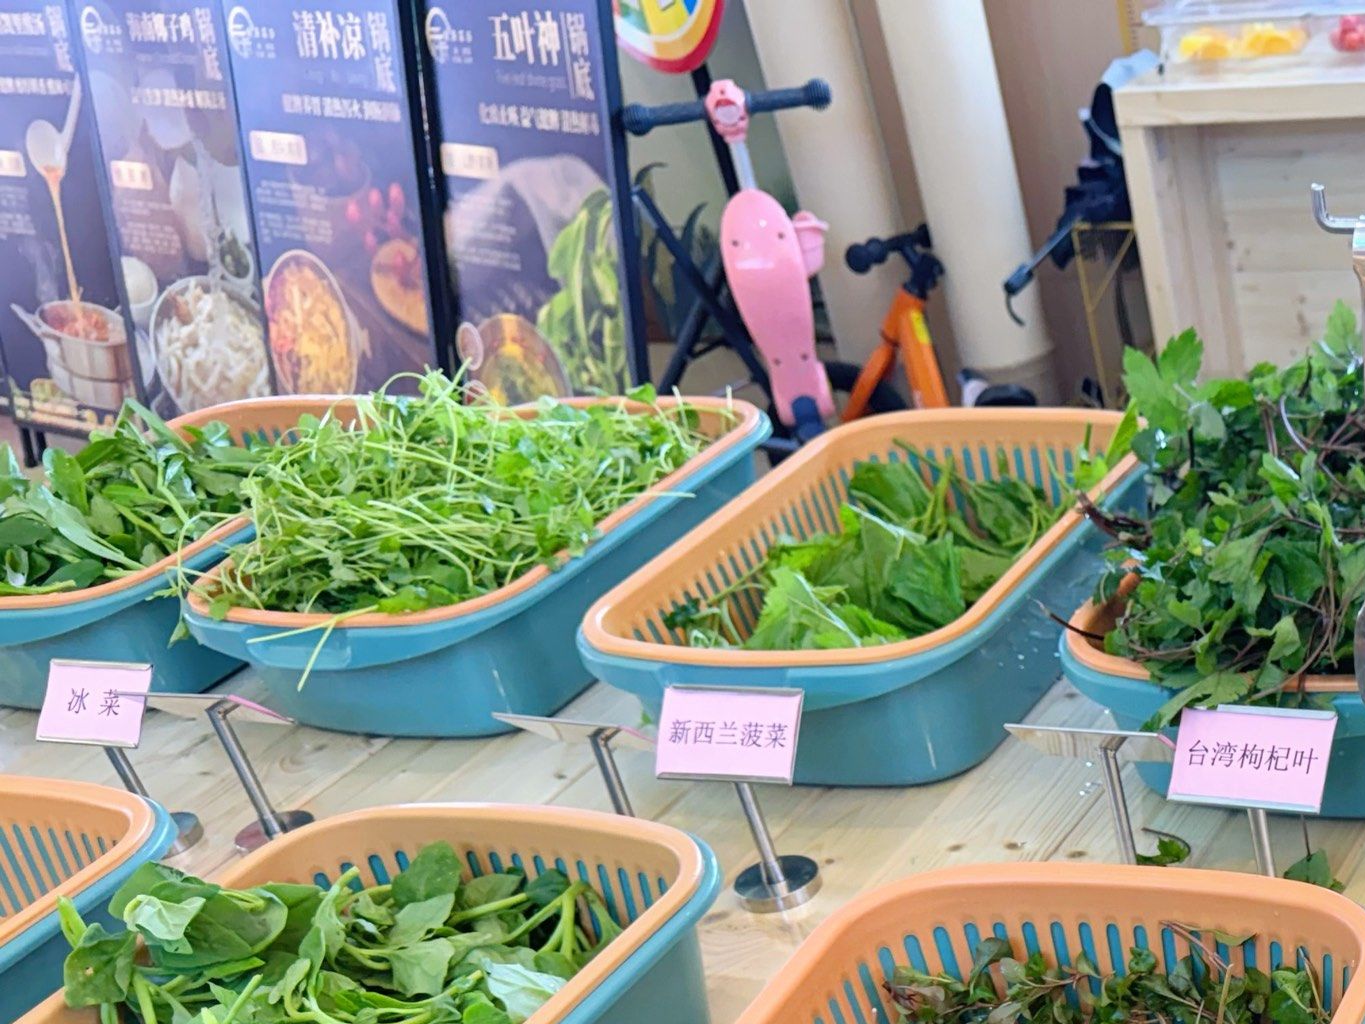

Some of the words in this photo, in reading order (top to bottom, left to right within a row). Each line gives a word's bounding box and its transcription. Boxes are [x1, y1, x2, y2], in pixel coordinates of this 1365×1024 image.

[292, 10, 366, 60] 清补凉
[487, 10, 561, 66] 五叶神
[67, 688, 121, 717] 冰菜
[669, 719, 788, 748] 新西兰菠菜
[1188, 740, 1319, 775] 台湾枸杞叶
